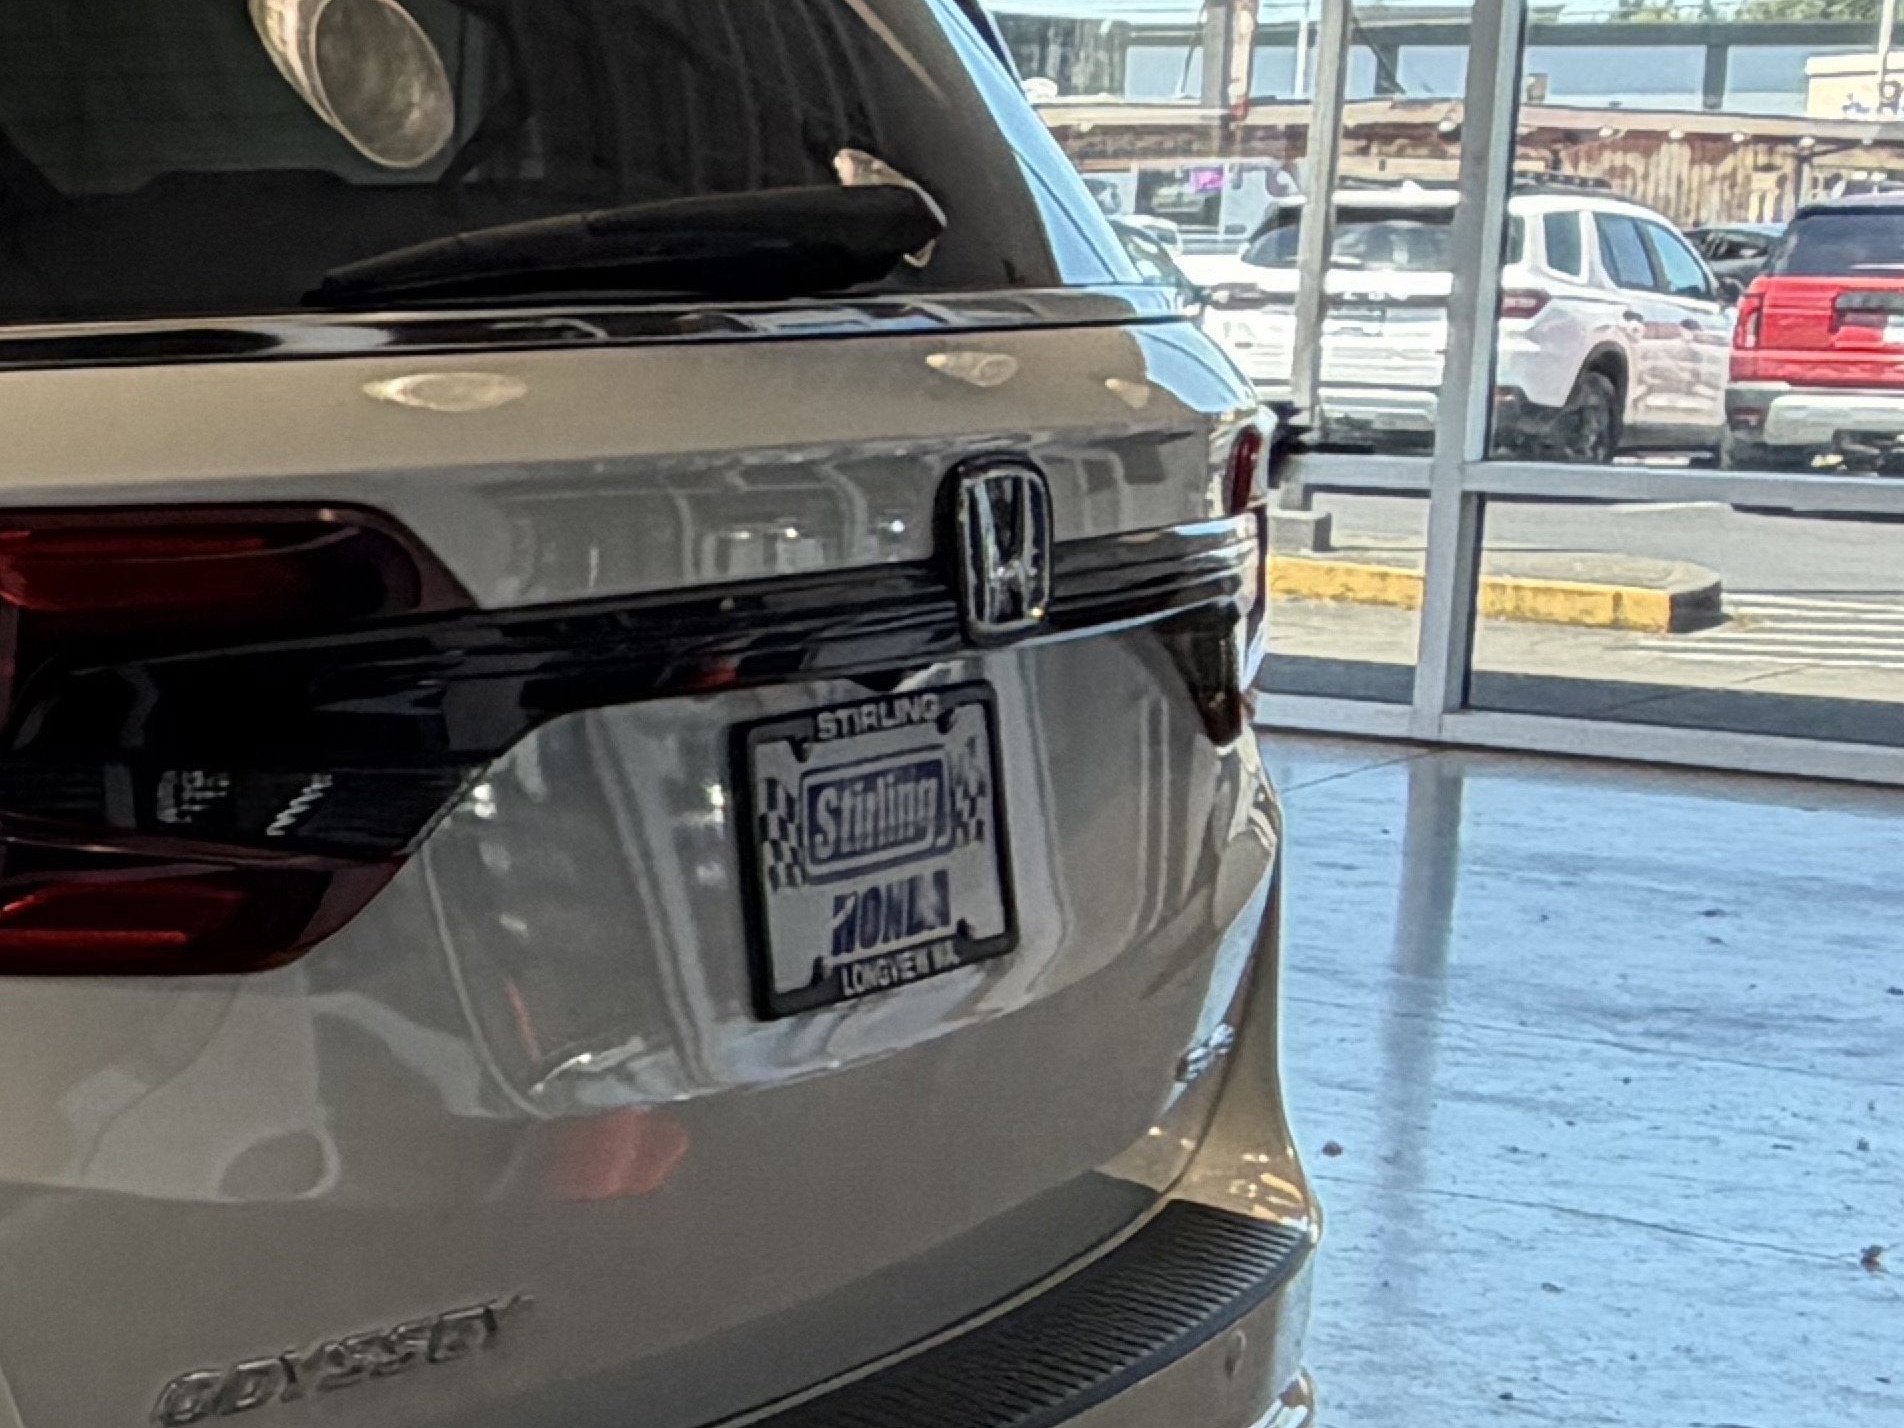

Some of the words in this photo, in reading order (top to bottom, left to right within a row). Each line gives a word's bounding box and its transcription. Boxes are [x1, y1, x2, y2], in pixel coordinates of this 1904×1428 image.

[816, 693, 941, 740] STIRLING
[814, 772, 939, 860] Stirling
[150, 1293, 536, 1428] ODYSSEY
